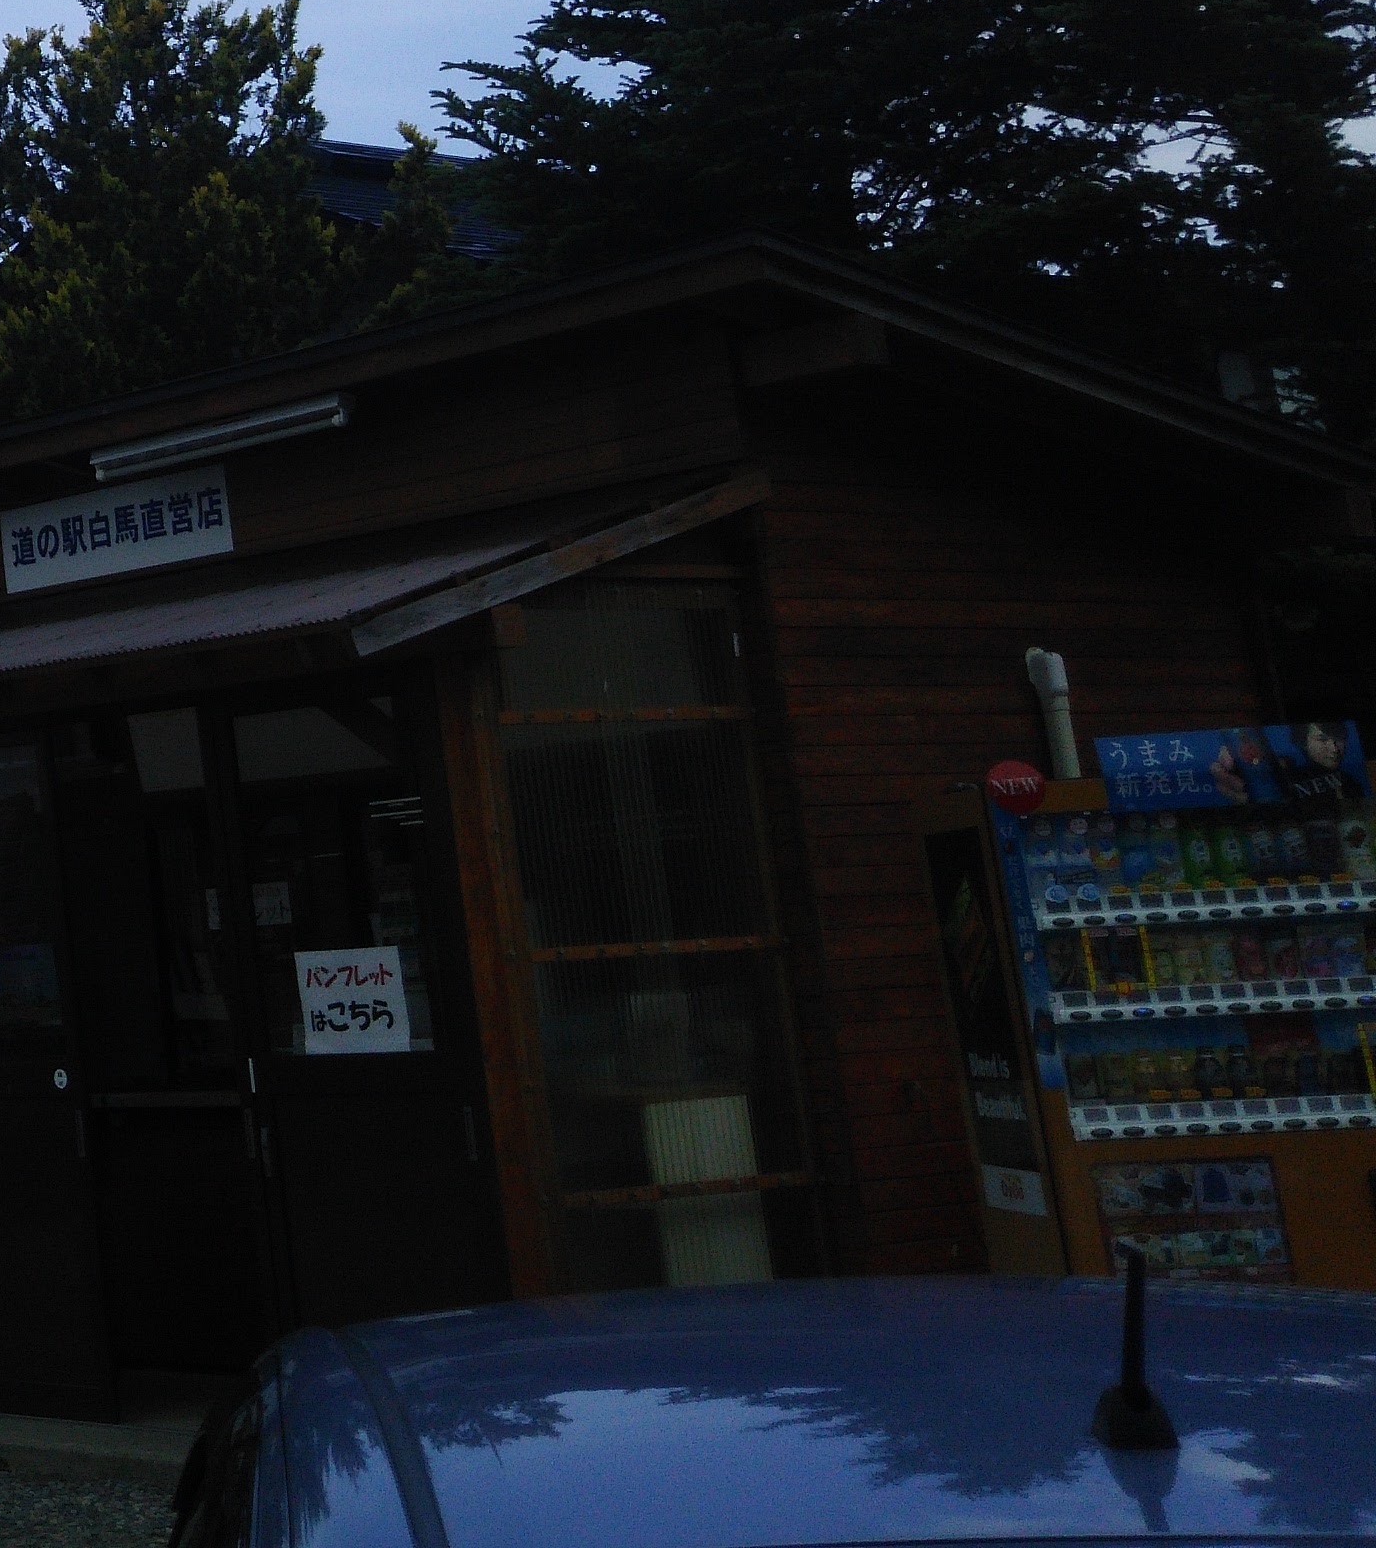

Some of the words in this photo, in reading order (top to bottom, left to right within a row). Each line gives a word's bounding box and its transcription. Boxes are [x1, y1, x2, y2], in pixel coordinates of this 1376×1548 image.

[11, 486, 224, 568] 道の駅白馬直営店
[1109, 737, 1196, 768] うまみ
[990, 775, 1043, 798] NEW
[1115, 768, 1213, 799] 新発見。
[1293, 772, 1344, 800] NEW
[306, 962, 394, 988] パンフレット
[310, 999, 395, 1033] はこちら
